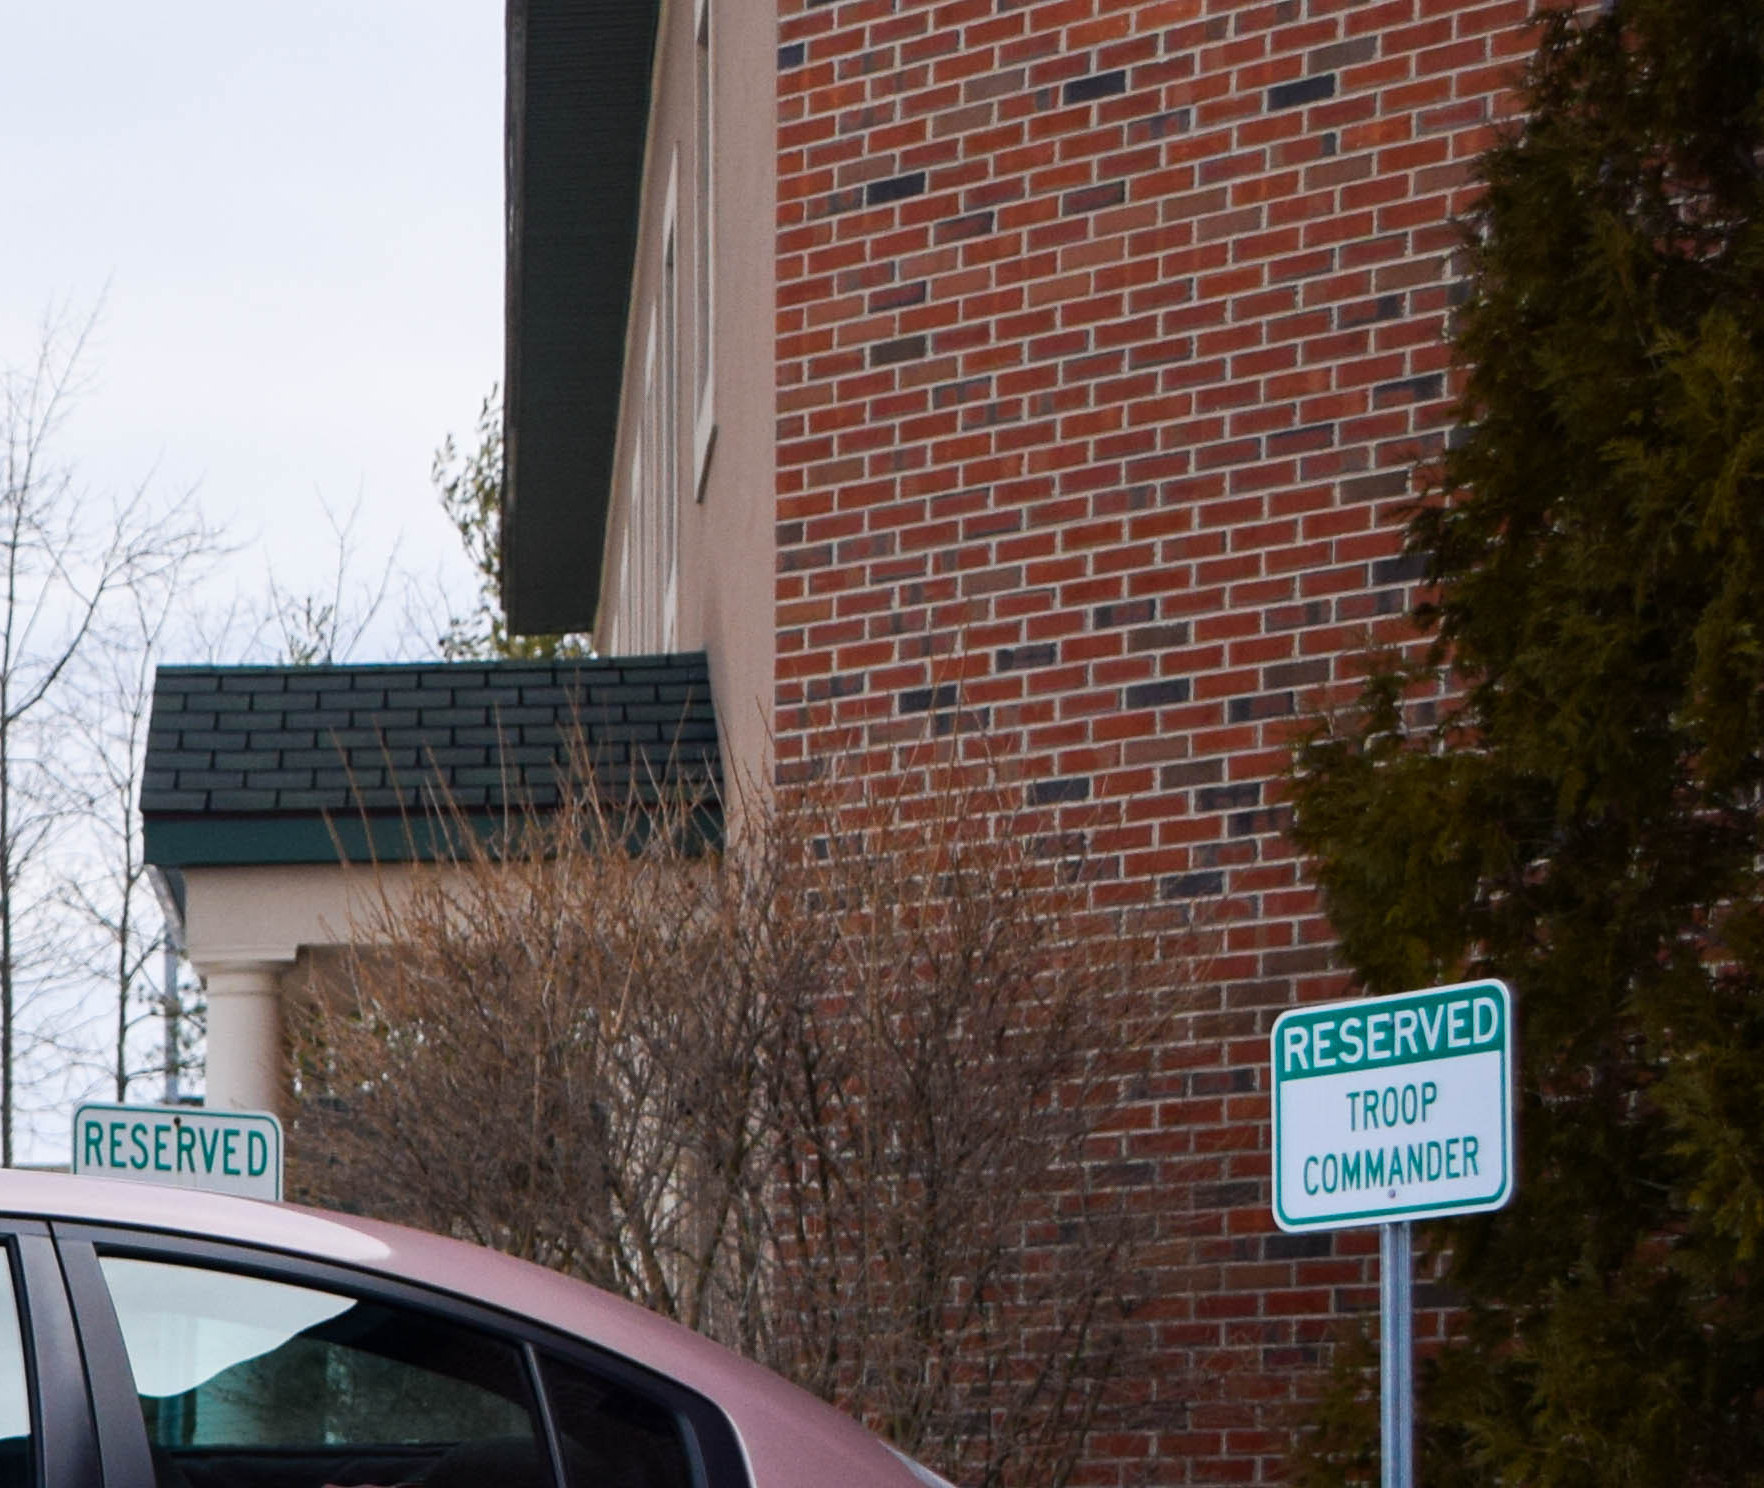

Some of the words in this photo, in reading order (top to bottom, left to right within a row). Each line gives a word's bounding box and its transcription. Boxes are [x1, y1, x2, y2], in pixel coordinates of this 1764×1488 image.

[1284, 997, 1499, 1072] RESERVED
[1346, 1081, 1438, 1132] TROOP
[85, 1121, 268, 1176] RESERVED
[1304, 1136, 1479, 1195] COMMANDER
